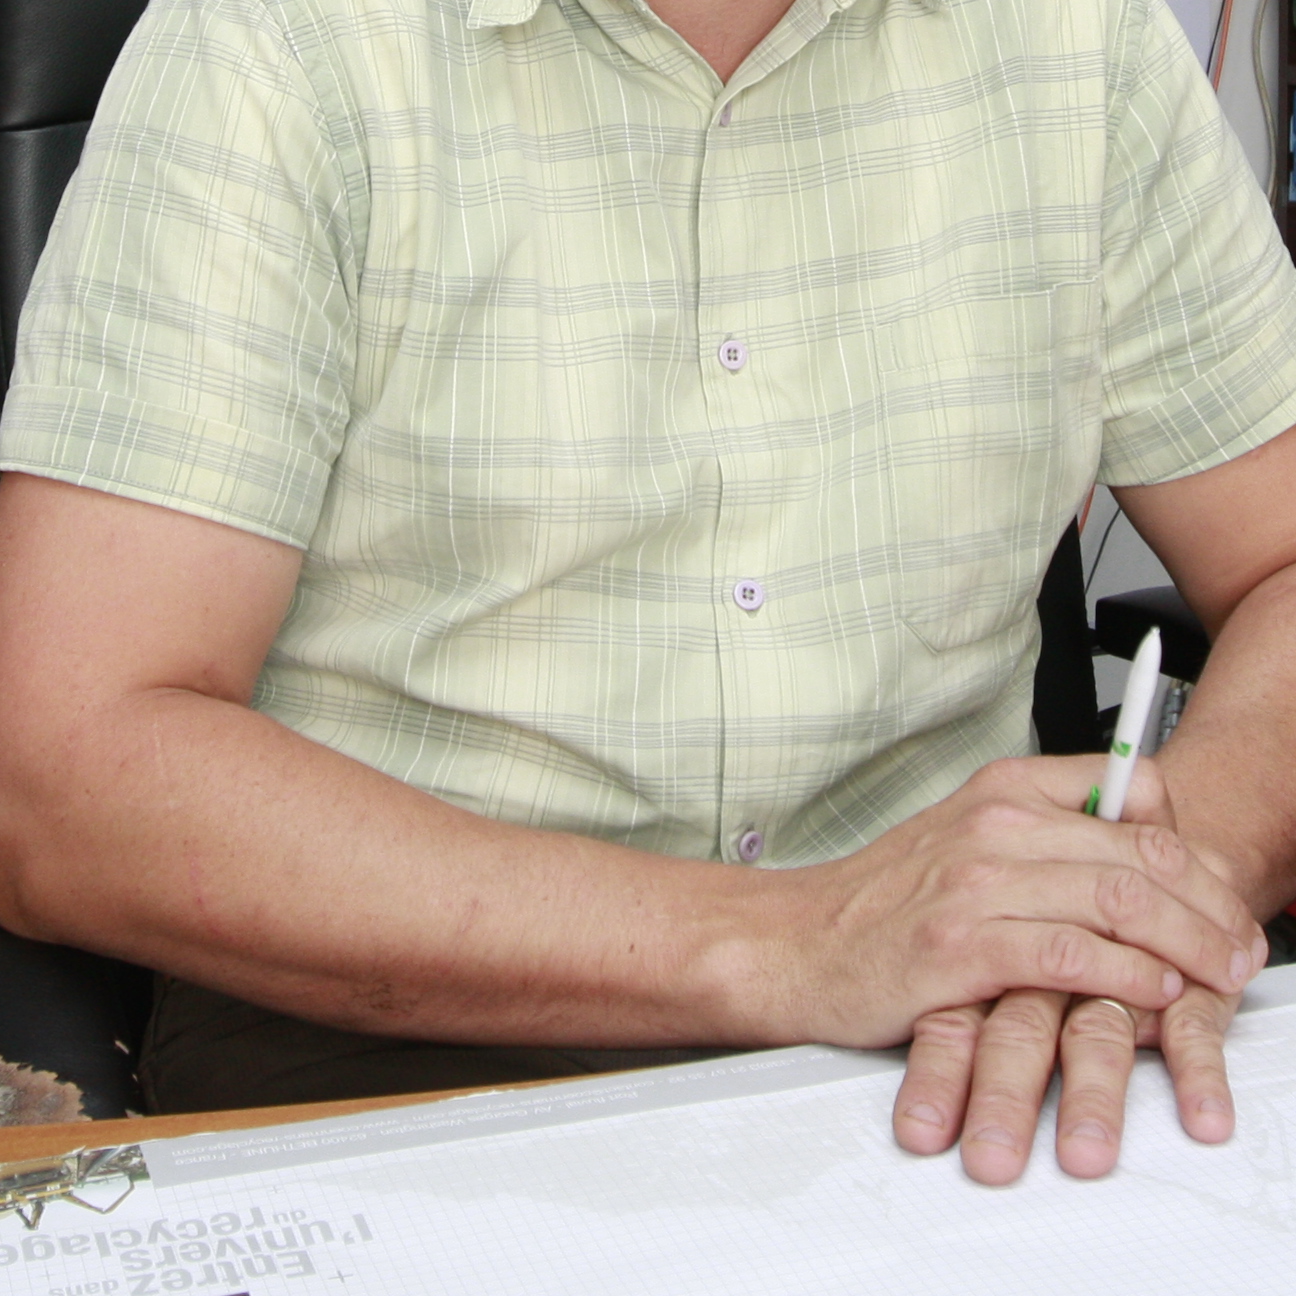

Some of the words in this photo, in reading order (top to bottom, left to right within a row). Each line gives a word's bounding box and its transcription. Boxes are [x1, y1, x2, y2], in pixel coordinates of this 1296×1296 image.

[245, 1140, 318, 1159] BETHUNE
[174, 1153, 227, 1166] France
[273, 1209, 307, 1226] du
[120, 1212, 374, 1272] l'univers
[128, 1249, 318, 1296] Entrez
[47, 1278, 120, 1296] dans
